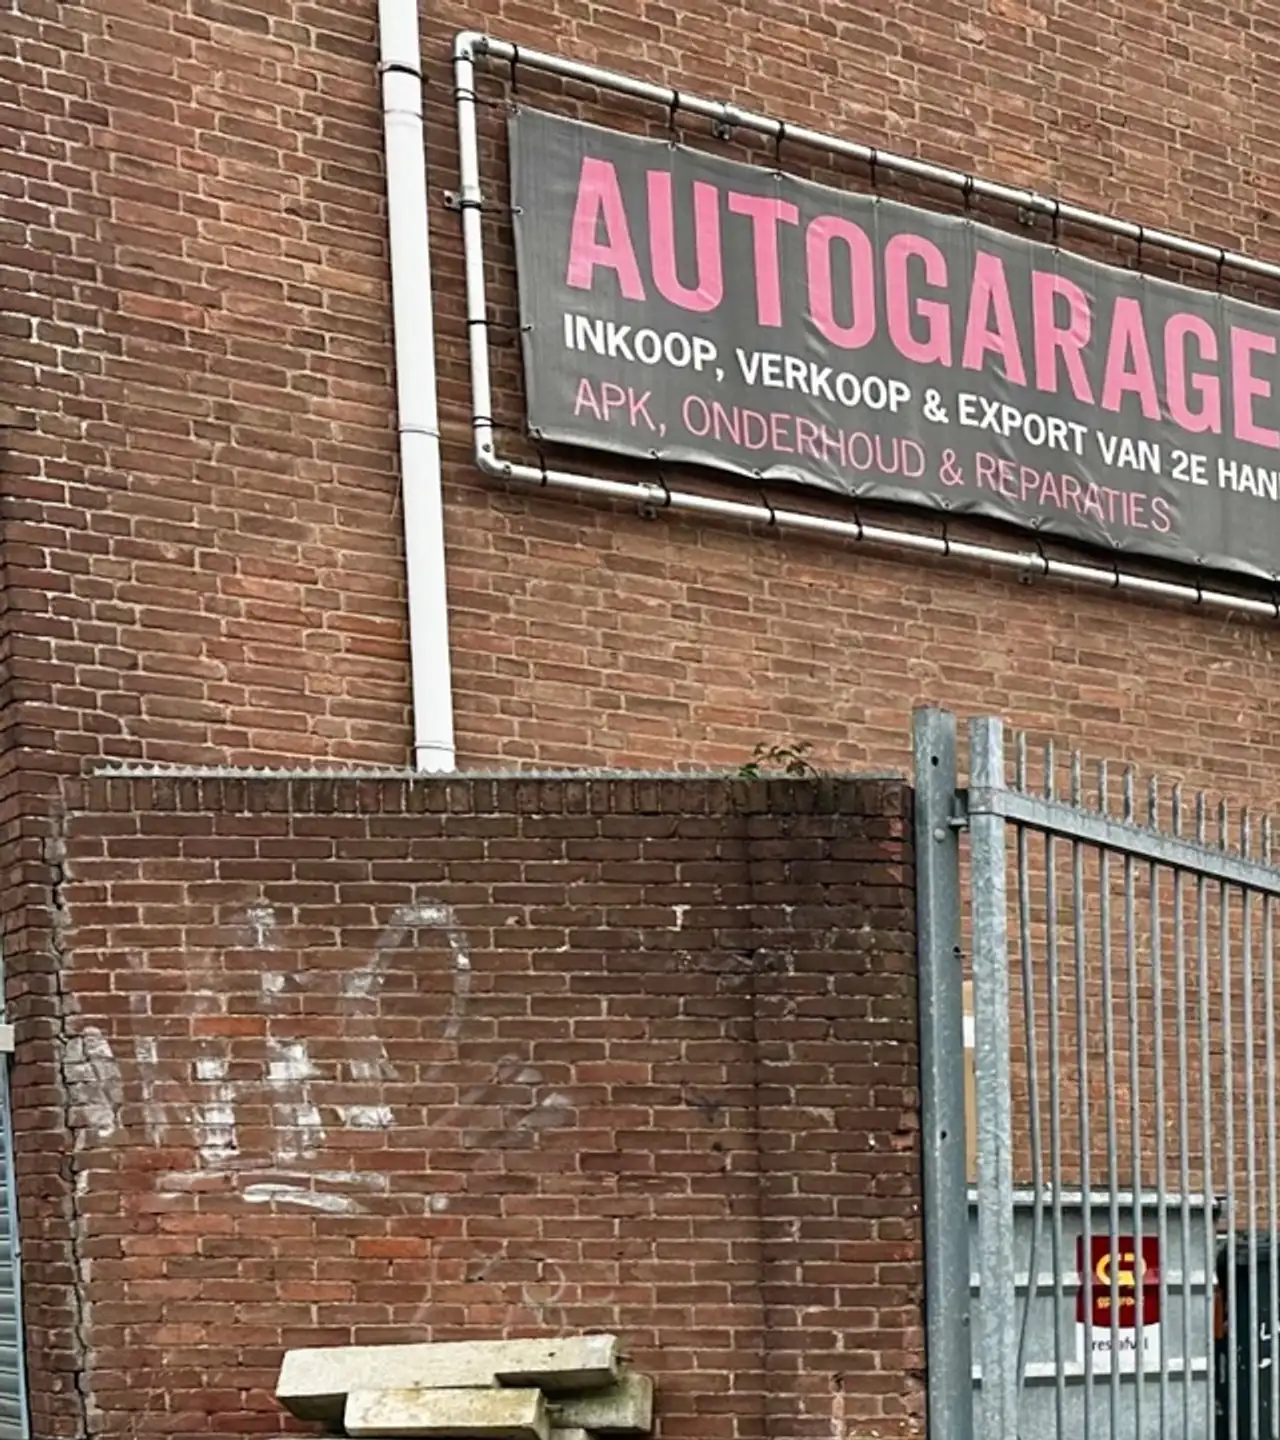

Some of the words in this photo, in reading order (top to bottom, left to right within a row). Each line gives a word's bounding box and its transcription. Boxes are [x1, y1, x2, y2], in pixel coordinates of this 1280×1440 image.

[563, 312, 725, 382] INKOOP,
[736, 347, 911, 412] VERKOOP
[923, 388, 949, 424] &
[958, 393, 1088, 456] EXPORT
[1096, 430, 1162, 475] VAN
[1171, 450, 1209, 486] 2E
[574, 377, 666, 438] APK,
[682, 394, 926, 478] ONDERHOUD
[939, 448, 965, 487] &
[975, 451, 1172, 533] REPARATIES
